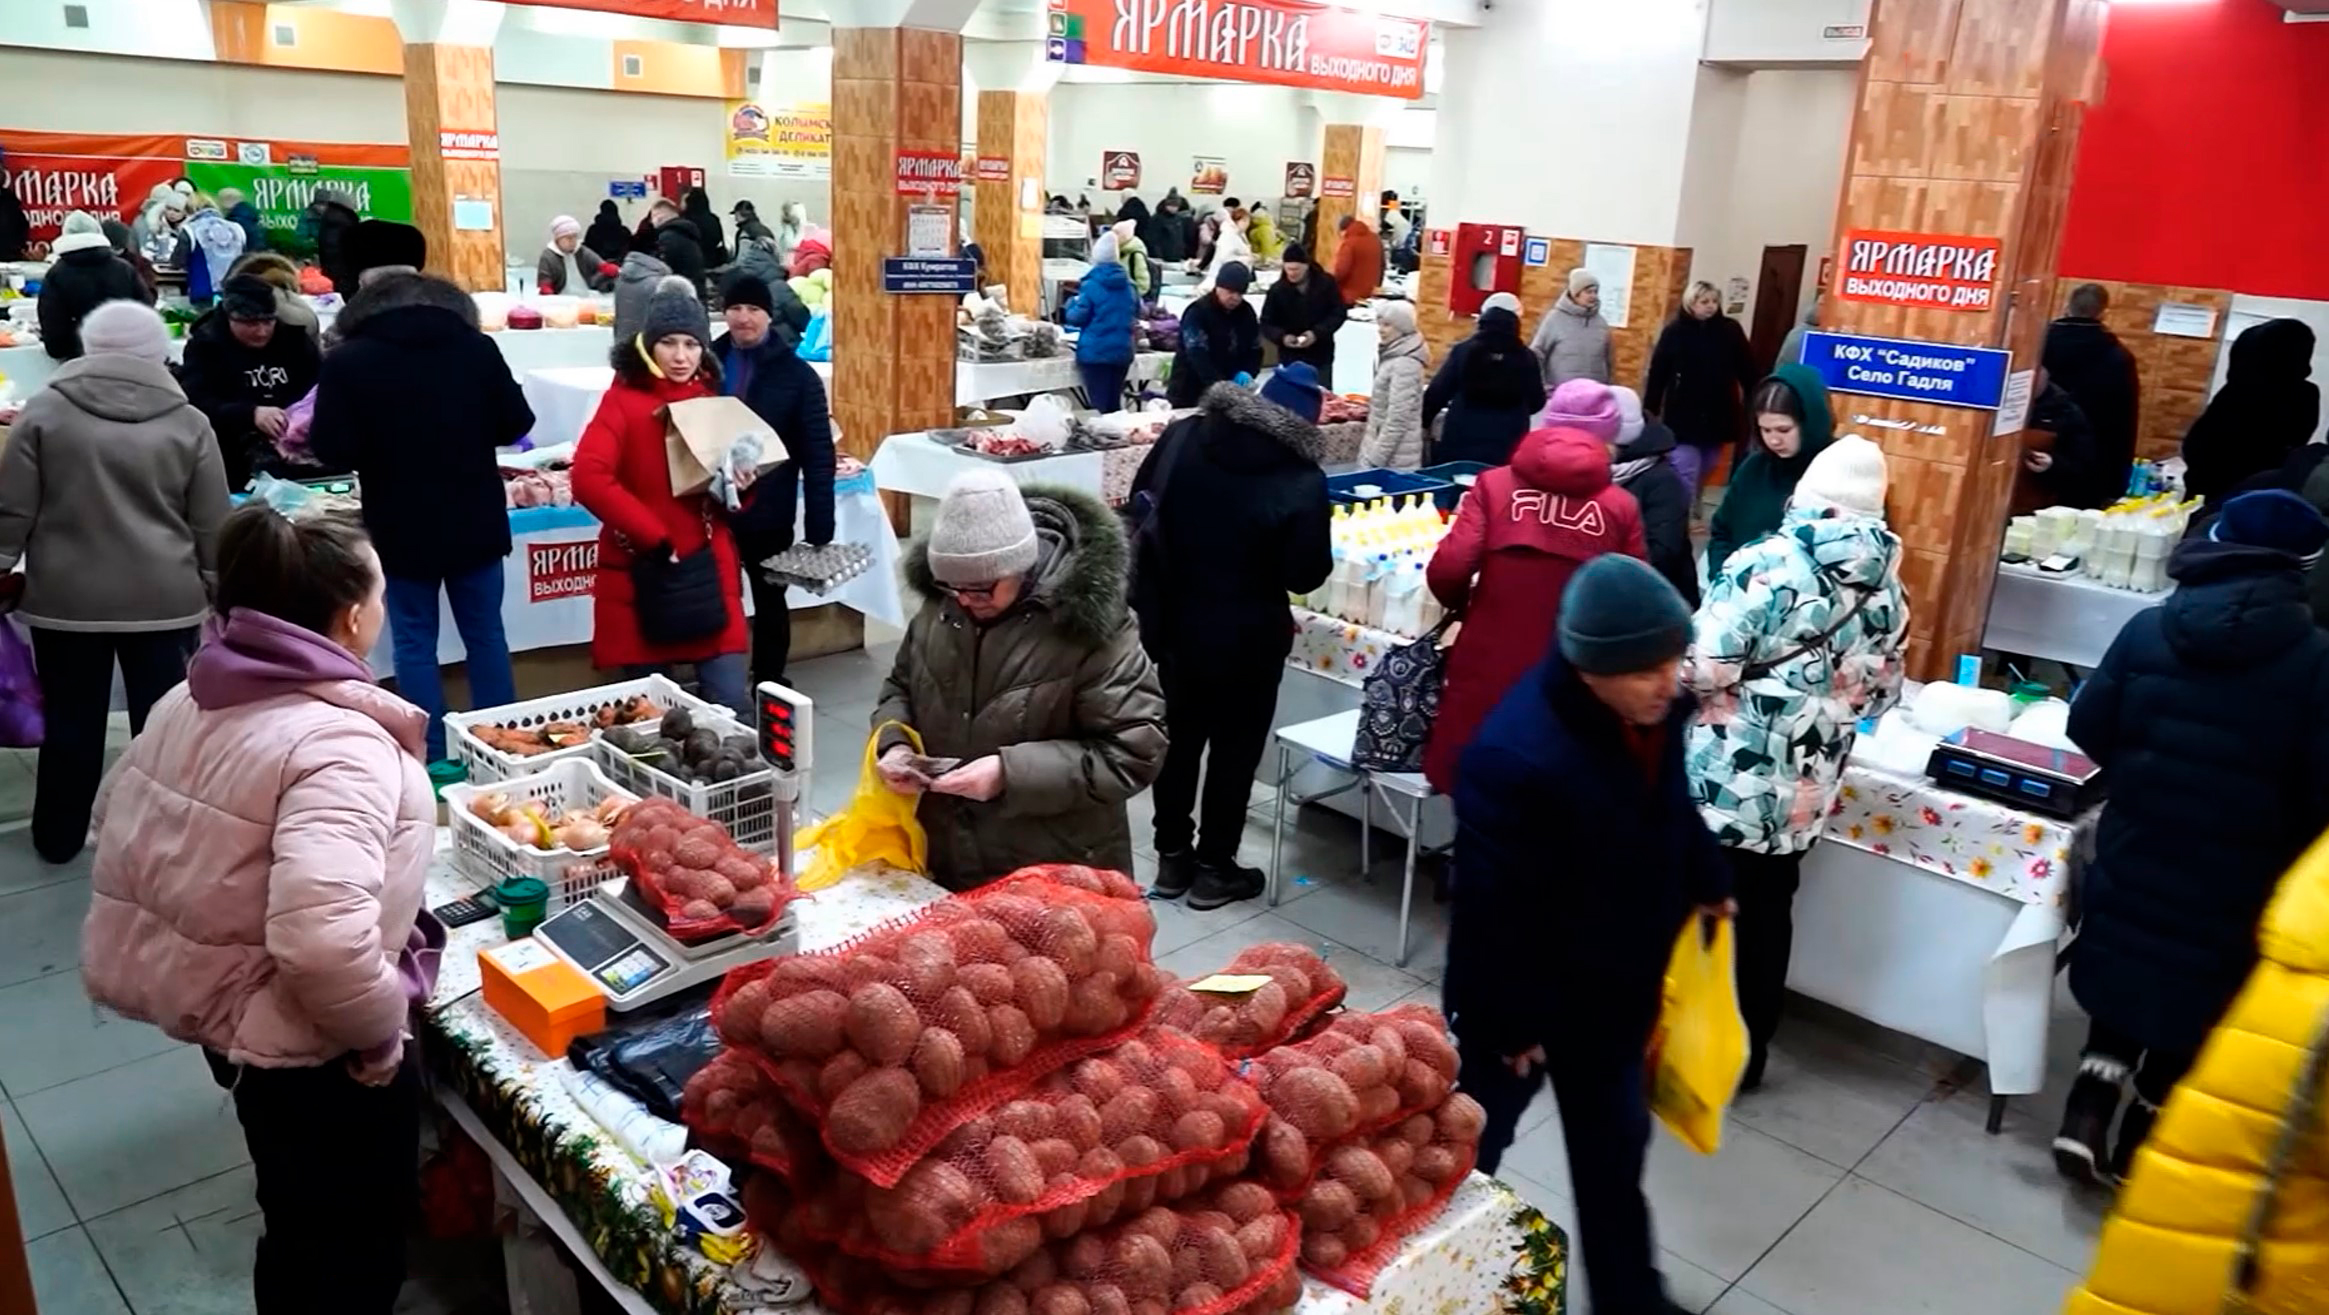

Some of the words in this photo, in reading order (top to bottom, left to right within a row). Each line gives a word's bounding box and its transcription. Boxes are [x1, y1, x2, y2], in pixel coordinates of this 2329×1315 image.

[1112, 0, 1309, 73] ЯРМАРКА
[1311, 55, 1391, 83] ВЫХОДНОГО
[1390, 65, 1417, 86] ДНЯ
[0, 168, 118, 206] МАРКА
[1483, 230, 1493, 245] 2
[1851, 240, 1997, 282] ЯРМАРКА
[1846, 277, 1951, 303] ВЫХОДНОГО
[1952, 286, 1990, 306] ДНЯ
[1834, 344, 1873, 363] КФХ
[1848, 366, 1894, 384] Село
[1897, 371, 1953, 391] Гадля
[1512, 489, 1605, 536] FILA
[533, 543, 599, 576] ЯРМА
